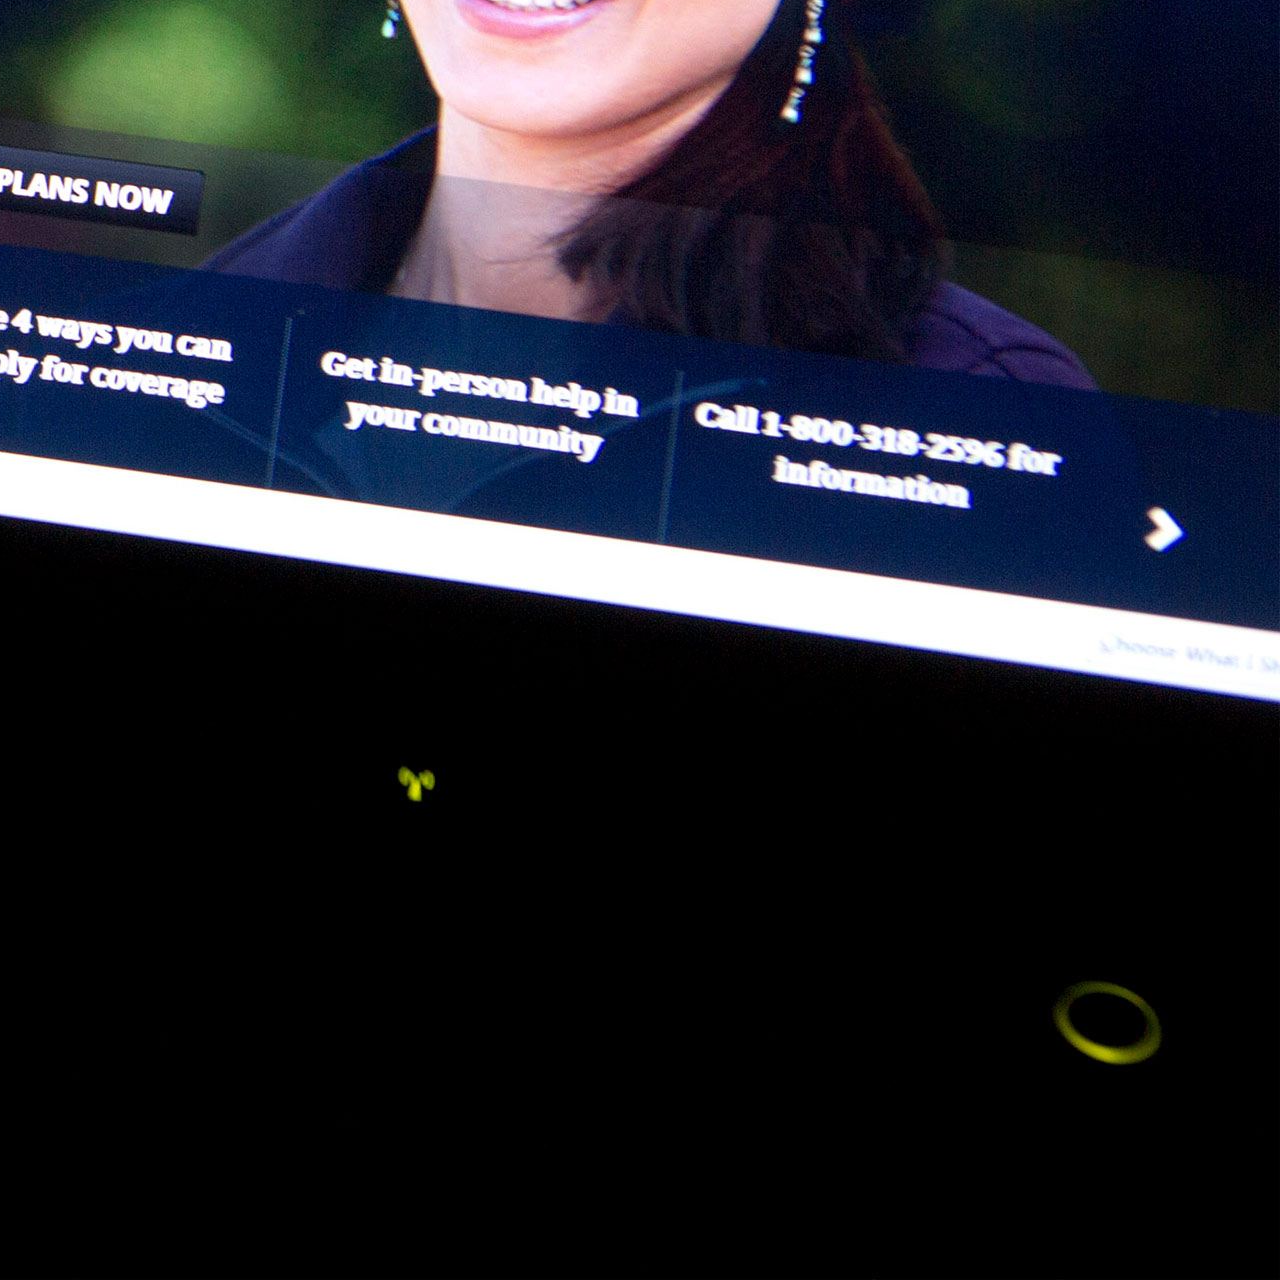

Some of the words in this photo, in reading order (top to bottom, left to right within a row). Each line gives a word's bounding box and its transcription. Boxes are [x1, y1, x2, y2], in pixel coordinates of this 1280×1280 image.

[94, 181, 174, 215] NOW
[10, 308, 34, 334] 4
[35, 315, 114, 349] ways
[112, 325, 174, 354] you
[175, 334, 233, 362] can
[38, 354, 90, 385] for
[89, 366, 226, 409] coverage
[320, 351, 378, 382] Get
[377, 356, 528, 403] in-person
[528, 376, 602, 419] help
[601, 387, 639, 418] in
[343, 401, 423, 432] your
[421, 412, 605, 463] community
[694, 402, 761, 435] Call
[760, 411, 1007, 468] 1-800-318-2596
[1005, 442, 1063, 477] for
[771, 455, 970, 509] information
